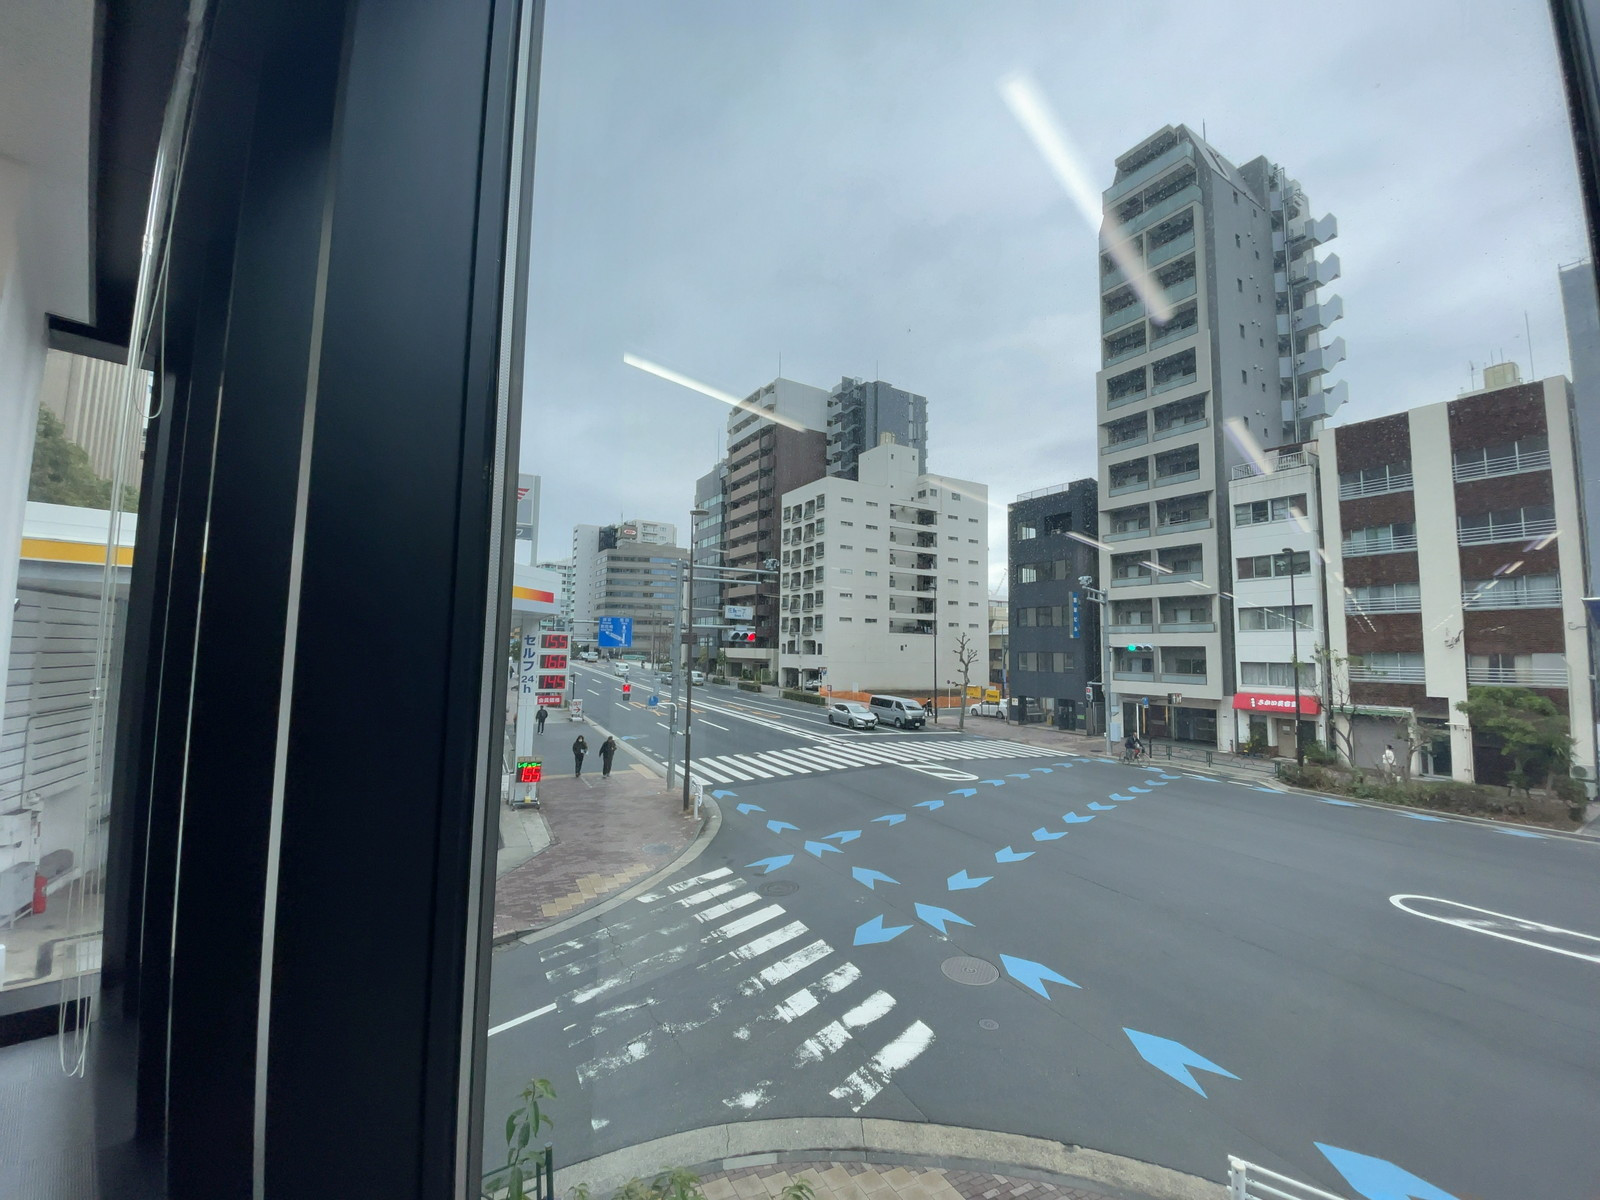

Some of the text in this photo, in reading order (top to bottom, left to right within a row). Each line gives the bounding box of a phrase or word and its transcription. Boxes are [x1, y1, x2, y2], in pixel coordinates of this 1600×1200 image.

[545, 634, 568, 649] 155
[523, 634, 536, 671] セルフ
[544, 654, 566, 669] 166
[543, 675, 565, 689] 145
[521, 766, 541, 782] 155
